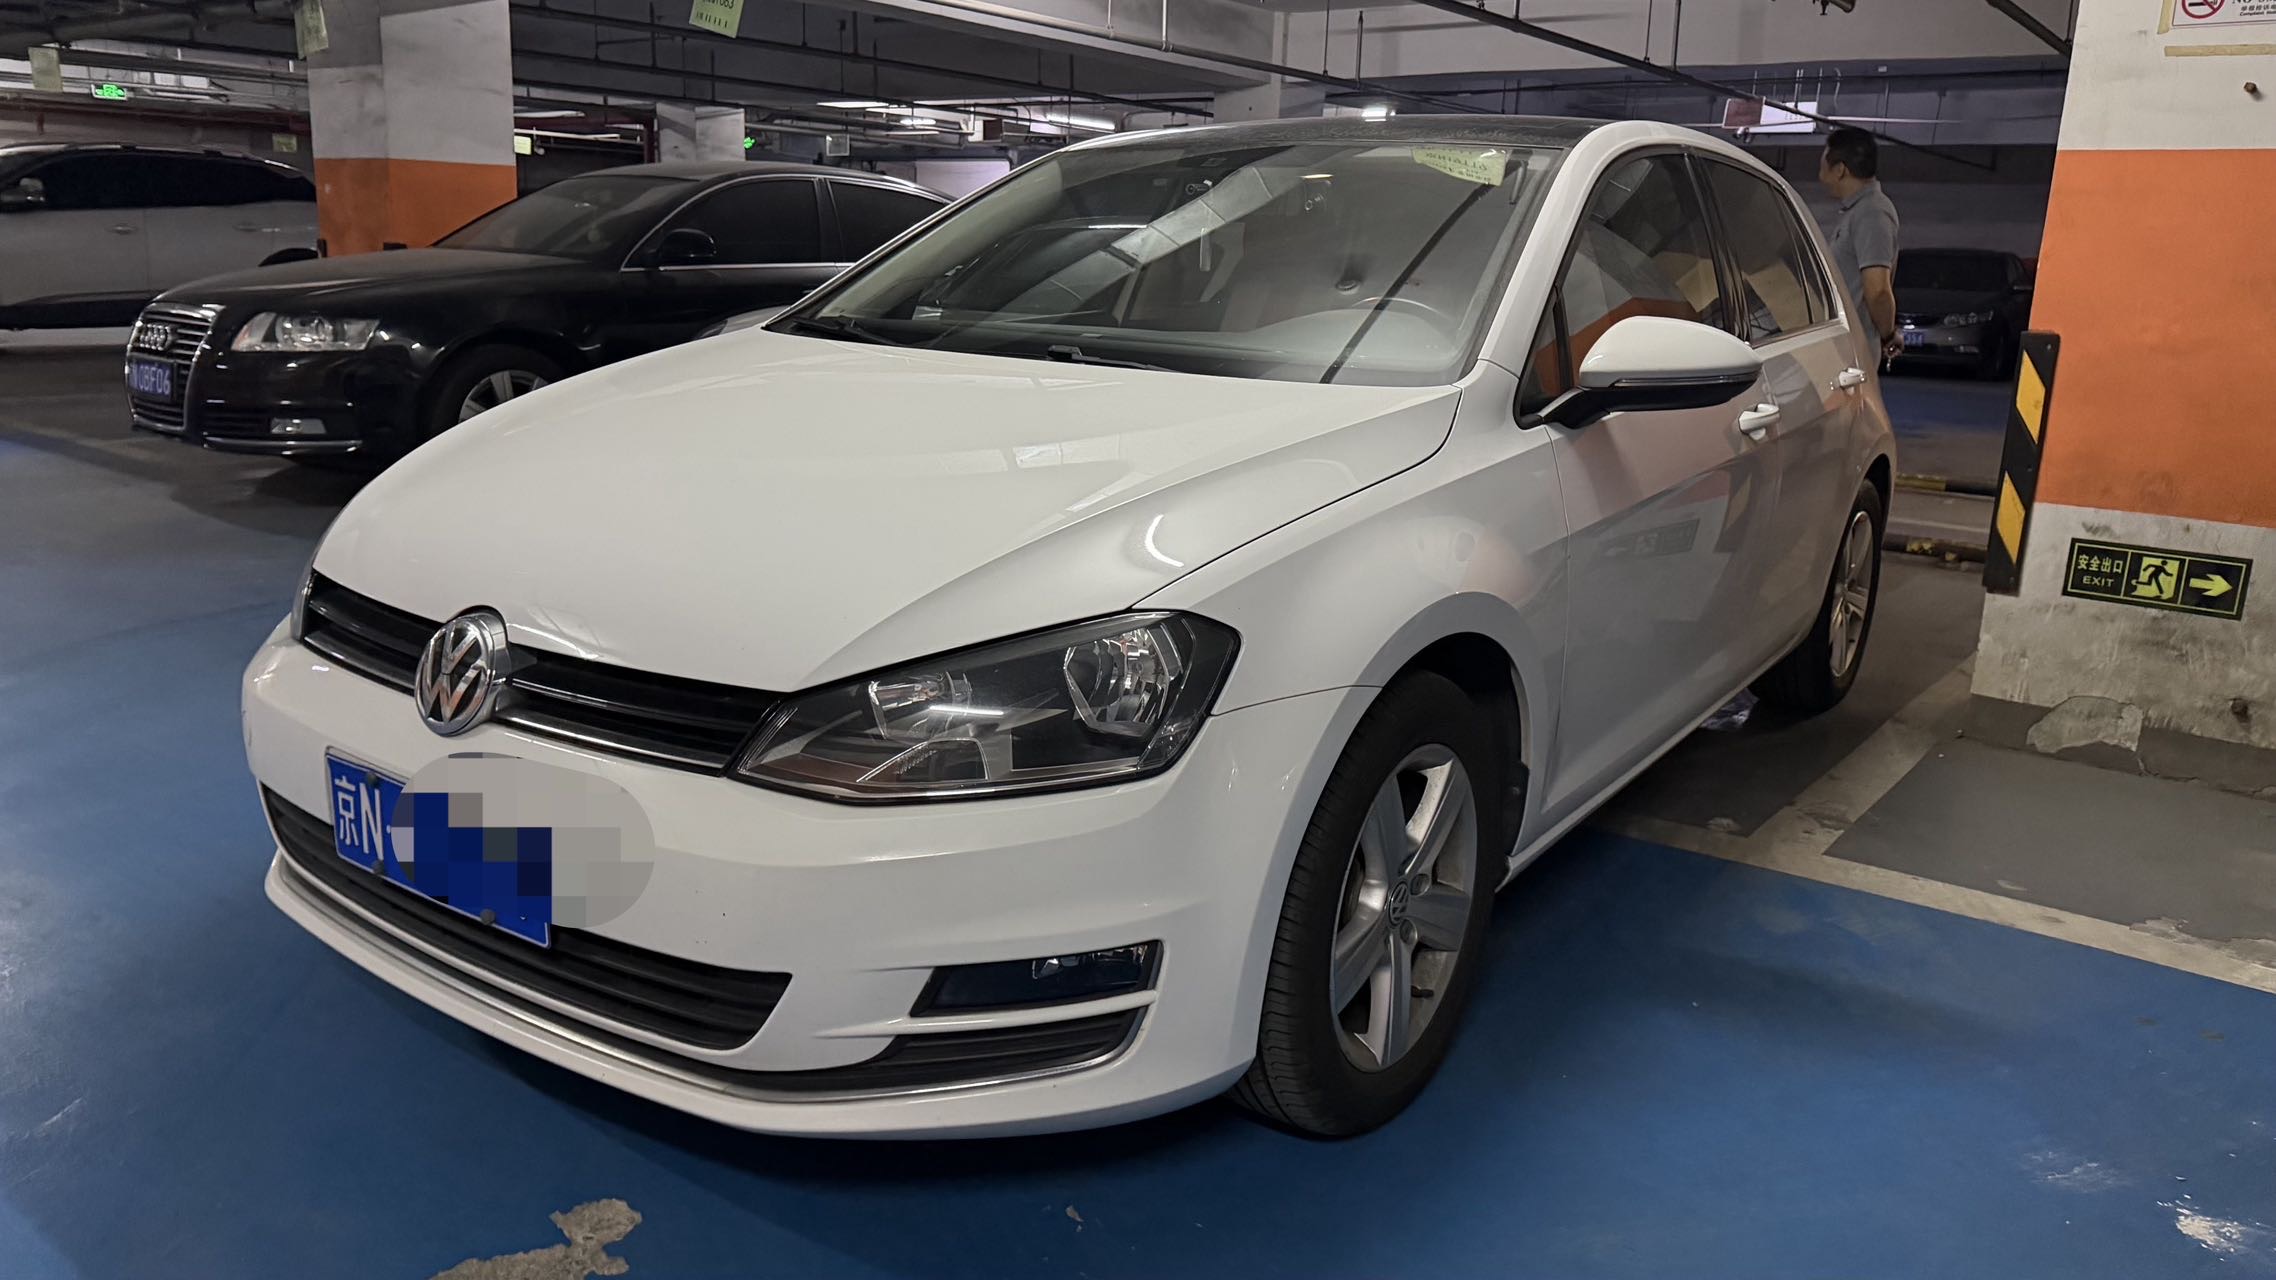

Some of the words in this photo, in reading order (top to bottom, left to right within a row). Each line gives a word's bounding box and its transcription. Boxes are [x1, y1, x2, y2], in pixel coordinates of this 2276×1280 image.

[2077, 554, 2123, 573] 安全出口
[2082, 575, 2114, 587] EXIT
